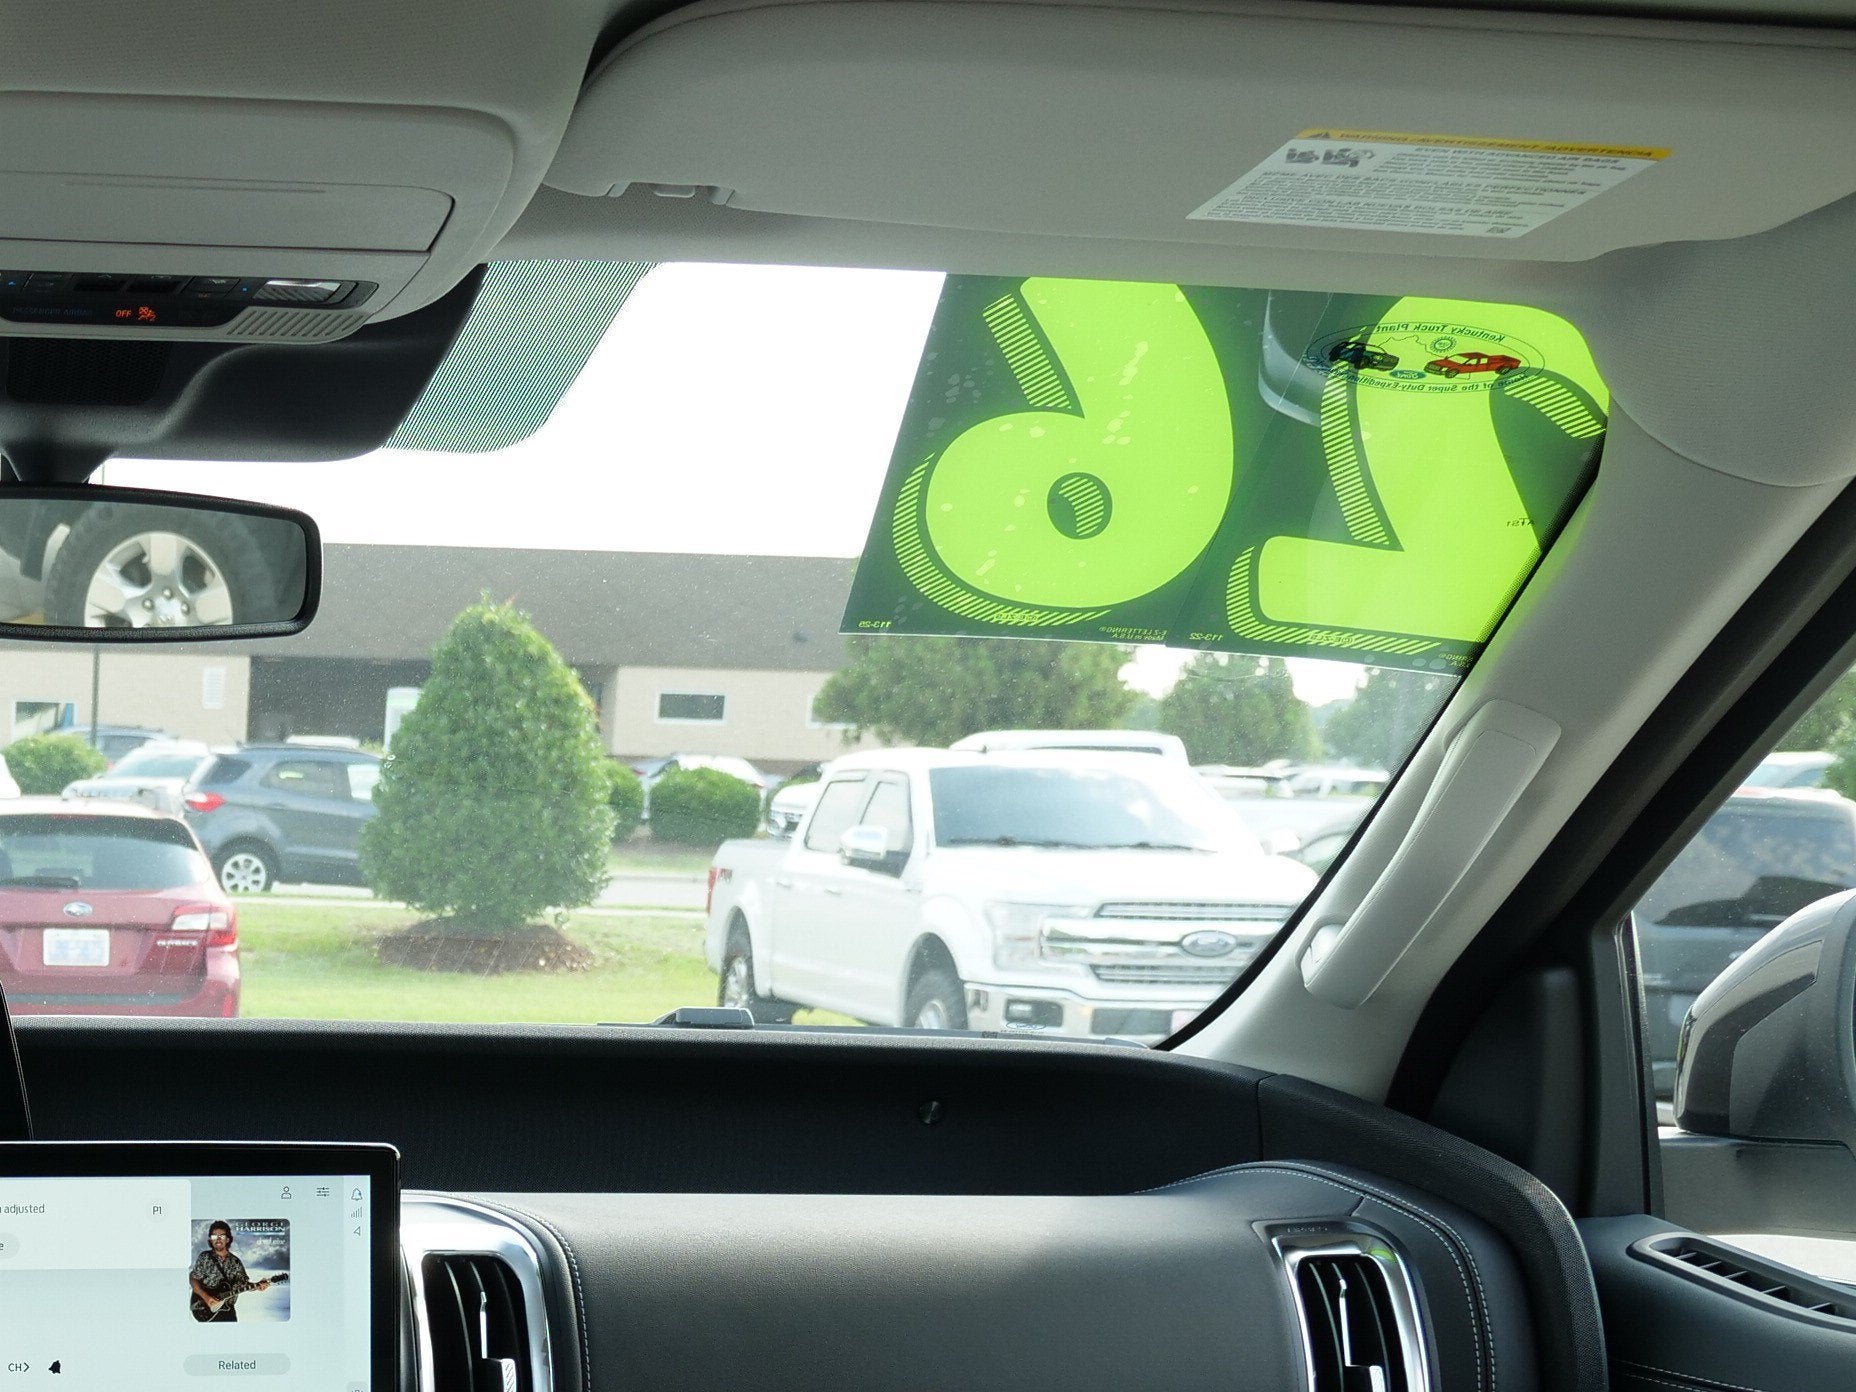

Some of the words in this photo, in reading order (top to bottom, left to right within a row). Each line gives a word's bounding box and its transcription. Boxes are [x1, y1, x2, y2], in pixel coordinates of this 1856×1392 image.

[115, 309, 132, 317] OFF
[3, 1203, 45, 1216] adjusted
[152, 1206, 163, 1215] P1
[218, 1360, 257, 1370] Related
